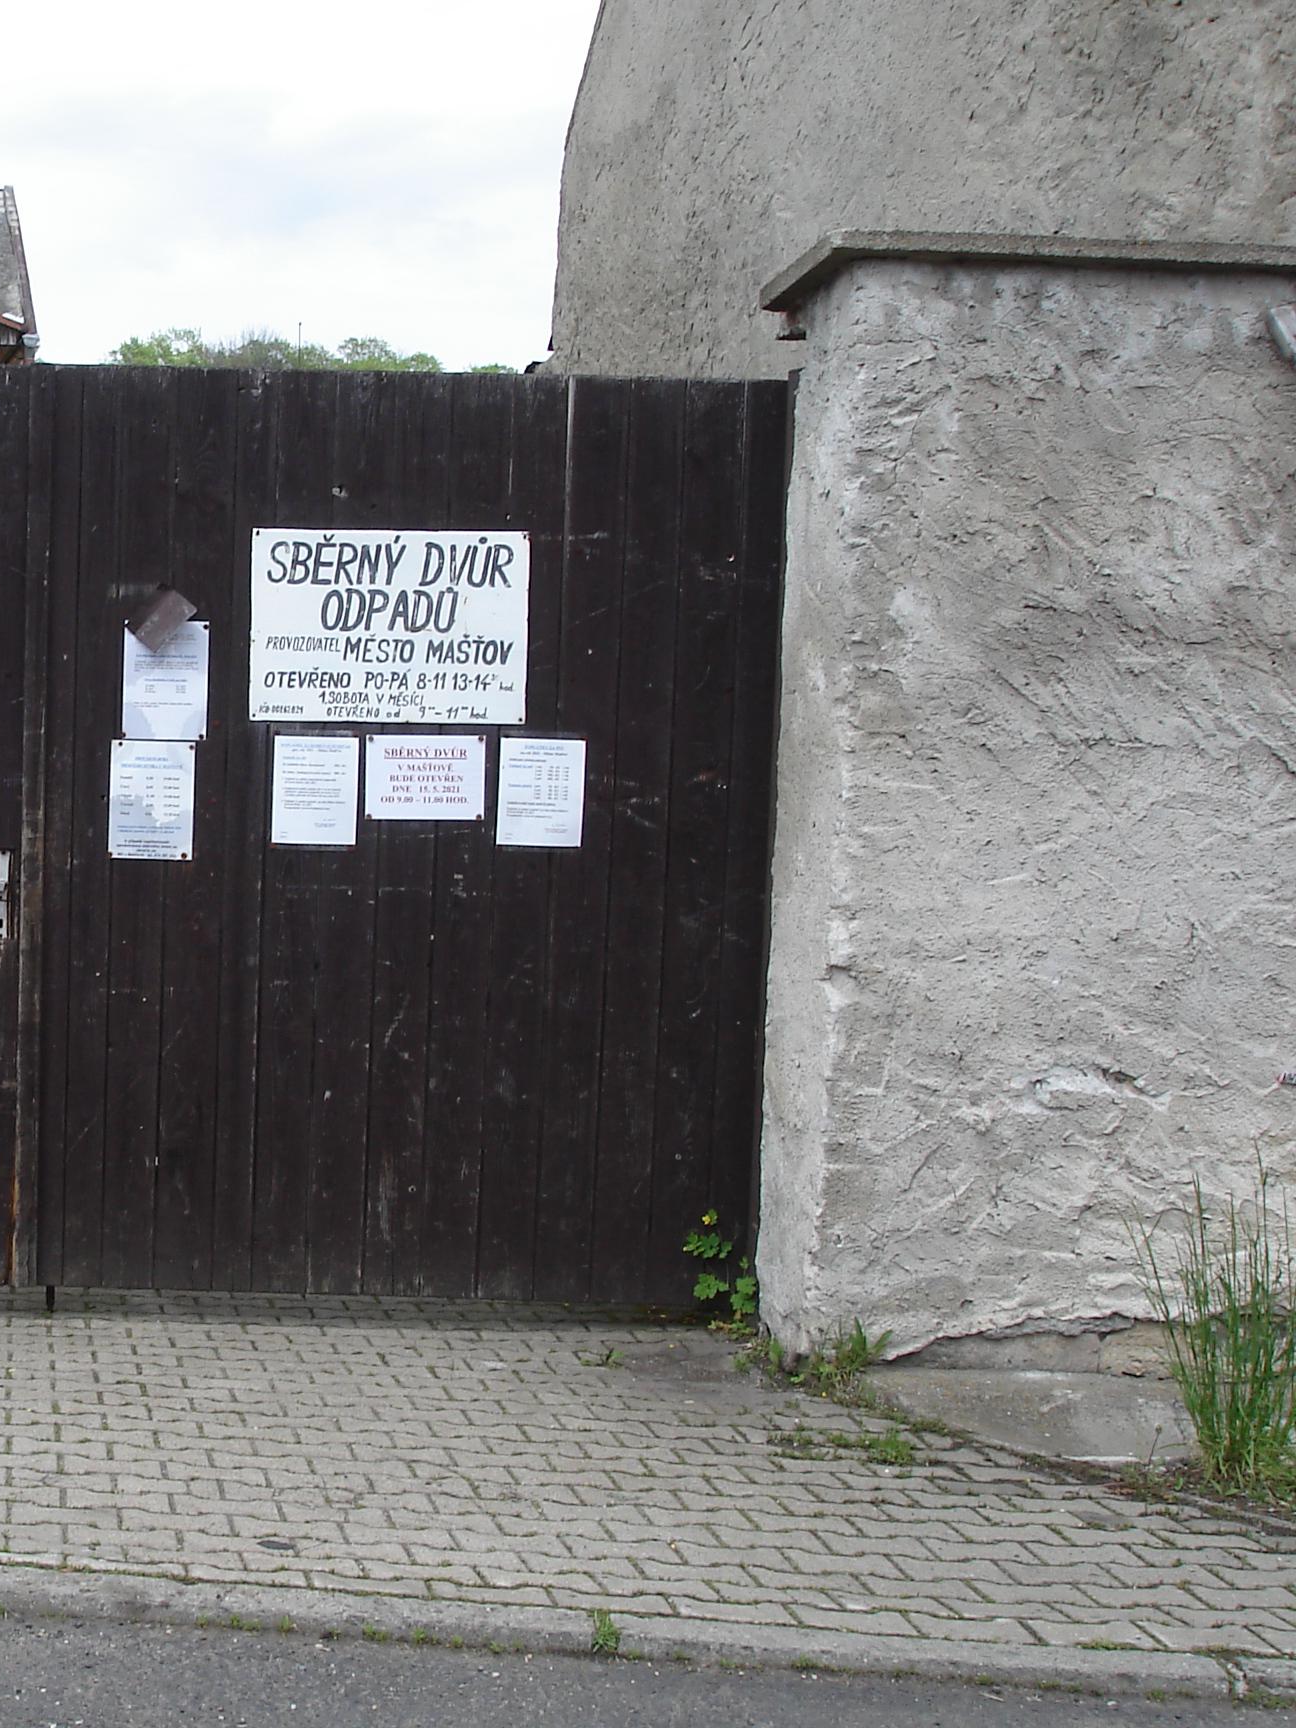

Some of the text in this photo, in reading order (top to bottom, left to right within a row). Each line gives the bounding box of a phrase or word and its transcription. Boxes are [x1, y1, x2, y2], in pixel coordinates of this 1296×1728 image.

[267, 534, 515, 588] SBĚRNÝ DVŮR
[321, 587, 459, 634] ODPADŮ
[265, 635, 513, 666] PROVOZOVATEL MĚSTO MAŠŤOV
[264, 667, 352, 689] OTEVŘENO
[364, 669, 412, 691] PO-PÁ
[376, 692, 385, 704] V
[326, 704, 380, 719] OTEVŘENO
[386, 707, 401, 718] od
[384, 745, 467, 759] SBĚRNÝ DVŮR
[389, 773, 464, 783] BUDE OTEVŘEN
[392, 785, 412, 793] DNE
